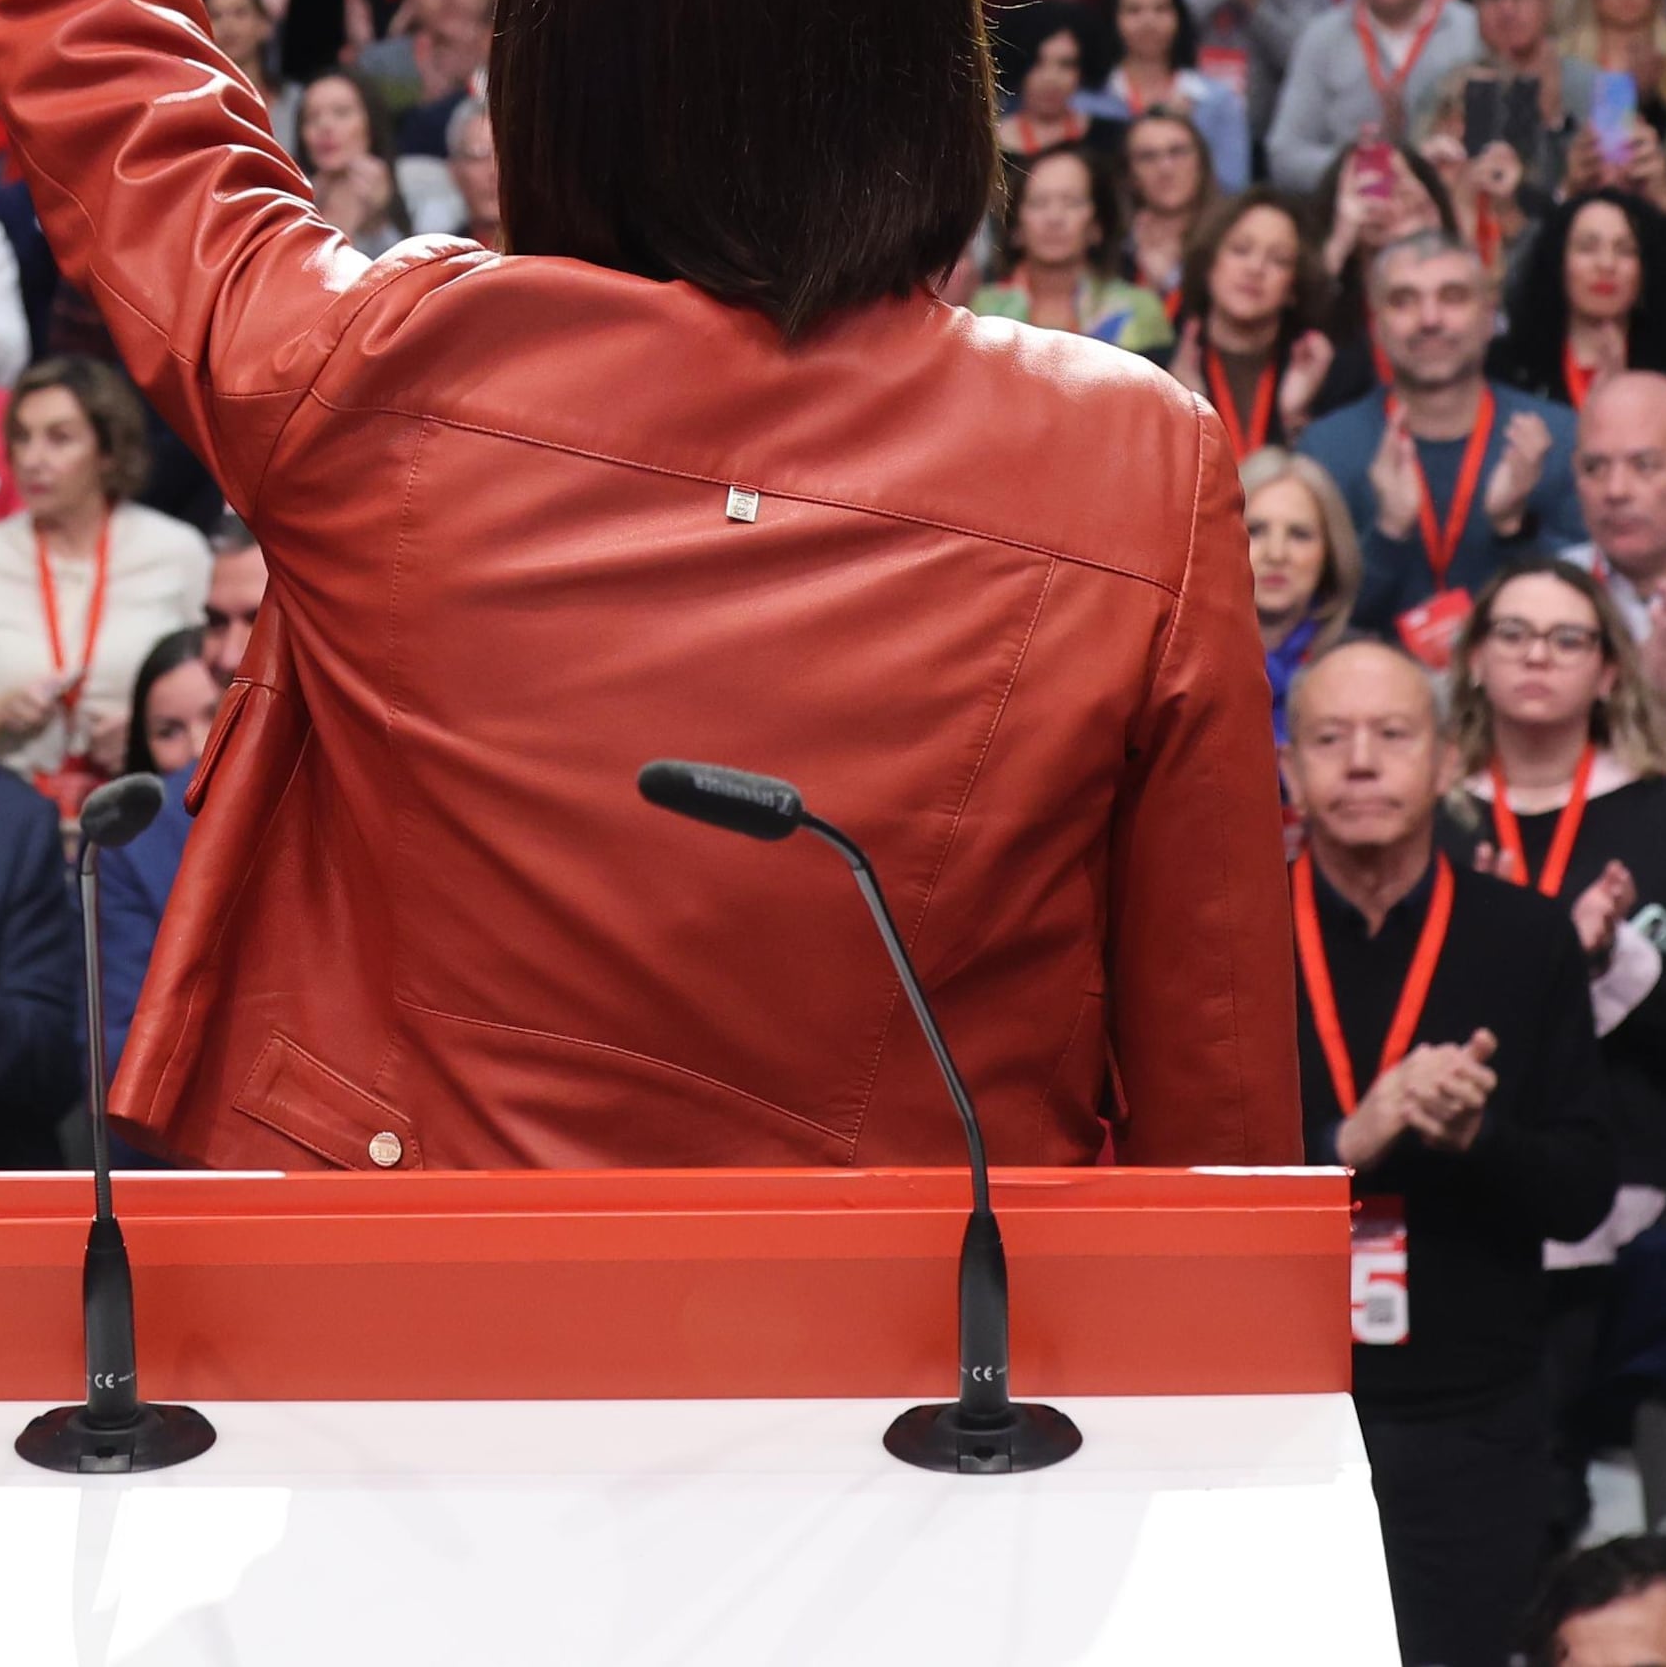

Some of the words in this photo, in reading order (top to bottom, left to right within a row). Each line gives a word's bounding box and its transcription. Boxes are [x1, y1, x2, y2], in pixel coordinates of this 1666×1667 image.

[1351, 1253, 1410, 1345] 5
[94, 1372, 115, 1389] CE
[972, 1365, 993, 1381] CE
